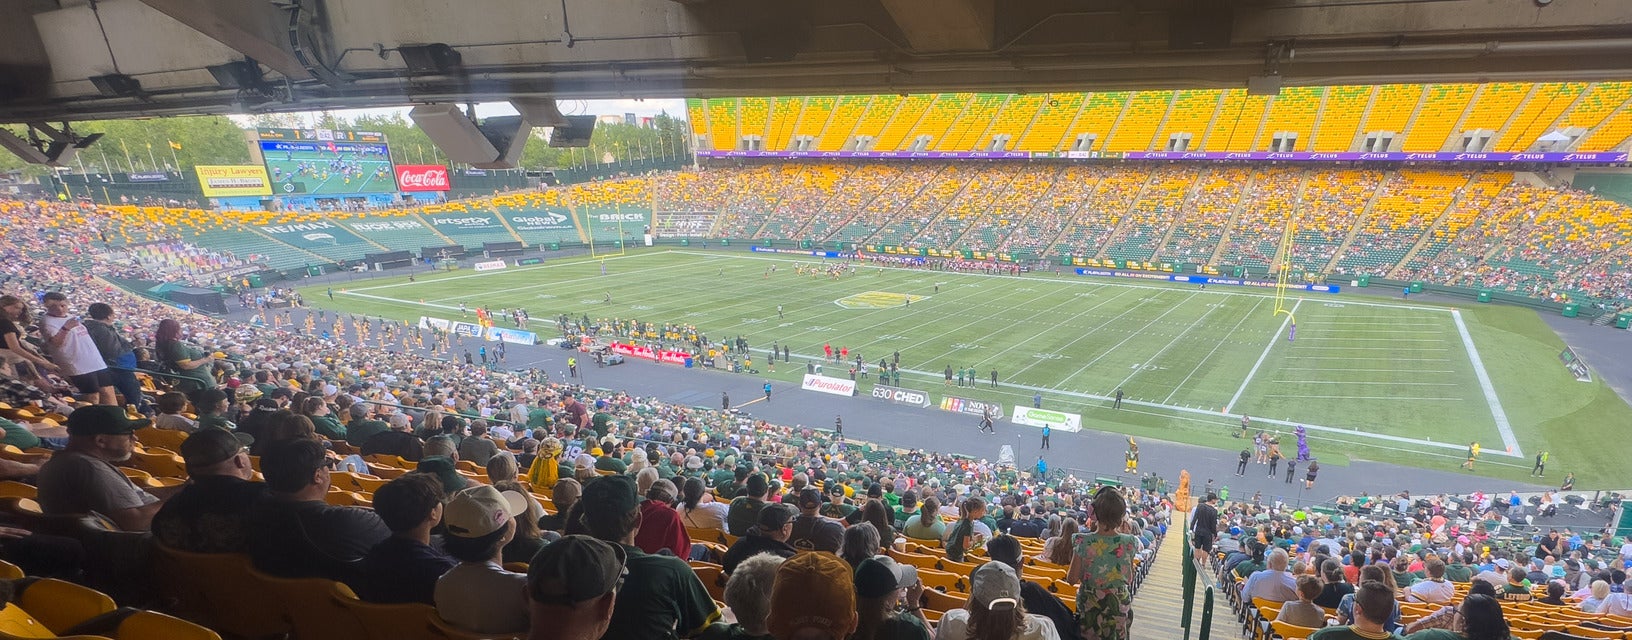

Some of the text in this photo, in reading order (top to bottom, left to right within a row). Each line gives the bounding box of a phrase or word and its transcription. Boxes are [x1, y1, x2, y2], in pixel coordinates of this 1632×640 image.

[200, 168, 227, 176] Injury
[401, 170, 445, 186] Coca-Cola
[260, 222, 335, 233] RE/MAX
[814, 379, 852, 392] Purolator
[872, 387, 923, 404] 630 CHED
